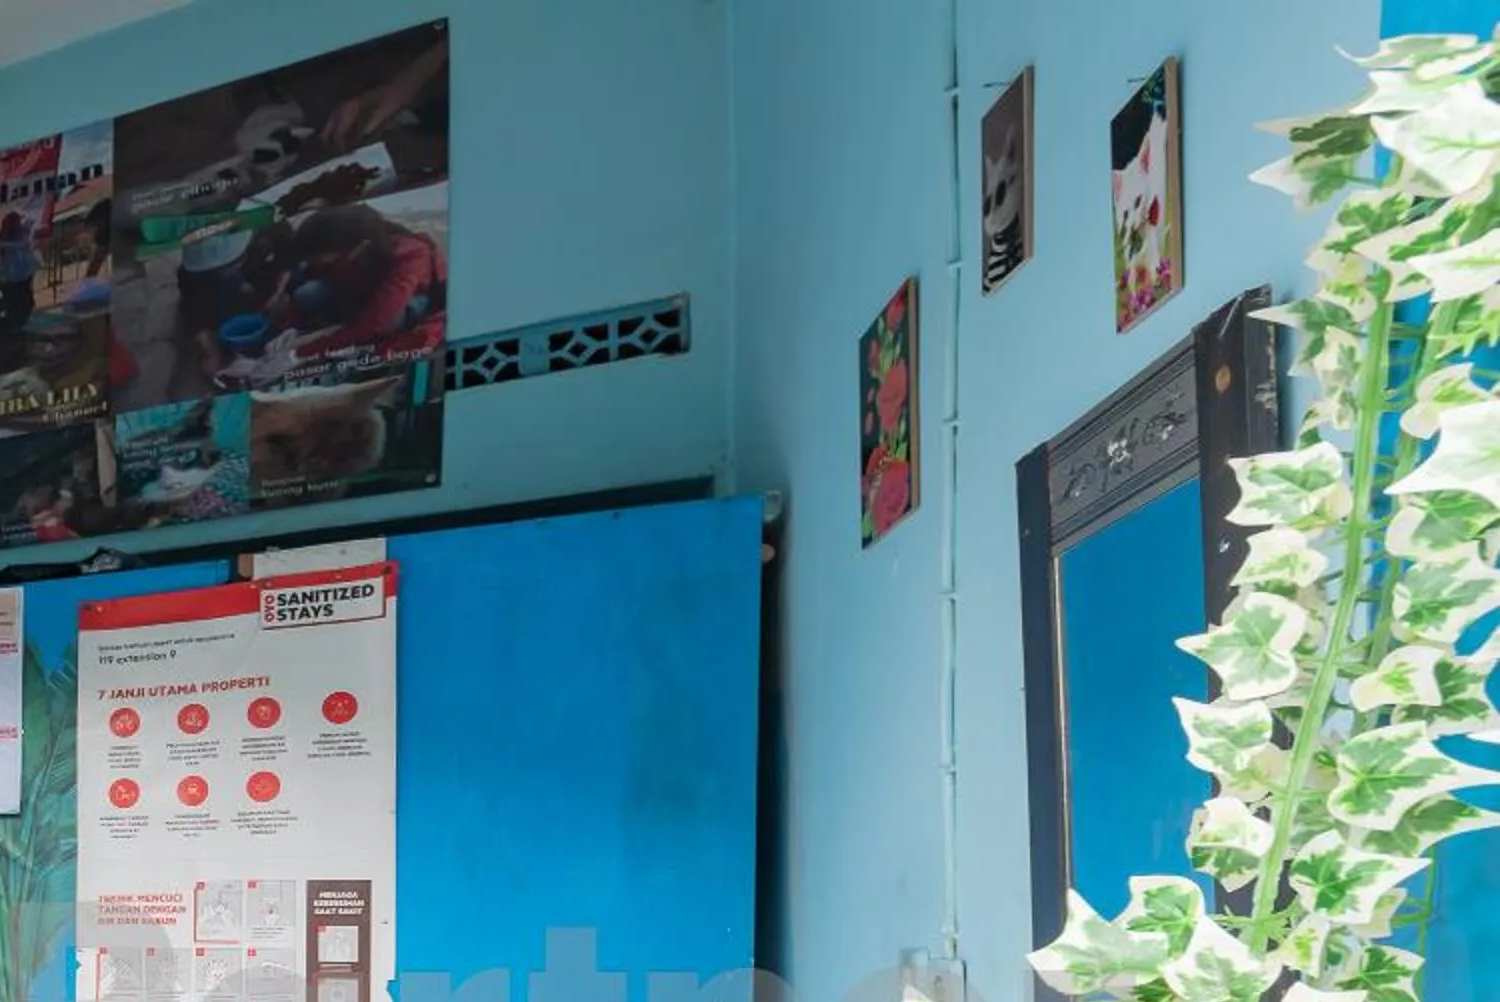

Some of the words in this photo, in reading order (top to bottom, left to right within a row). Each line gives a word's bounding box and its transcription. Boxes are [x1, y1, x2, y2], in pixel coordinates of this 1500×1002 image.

[264, 594, 275, 623] OYO
[277, 584, 375, 607] SANITIZED
[277, 604, 334, 621] STAYS
[99, 656, 113, 666] 119
[116, 653, 167, 665] extension
[170, 650, 177, 660] 9
[99, 691, 105, 700] 7
[110, 687, 145, 700] JANJI
[149, 683, 197, 698] UTAMA
[201, 676, 271, 693] PROPERTI
[137, 893, 183, 903] MENCUCI
[98, 904, 141, 914] TANGAN
[144, 904, 187, 914] DENGAN
